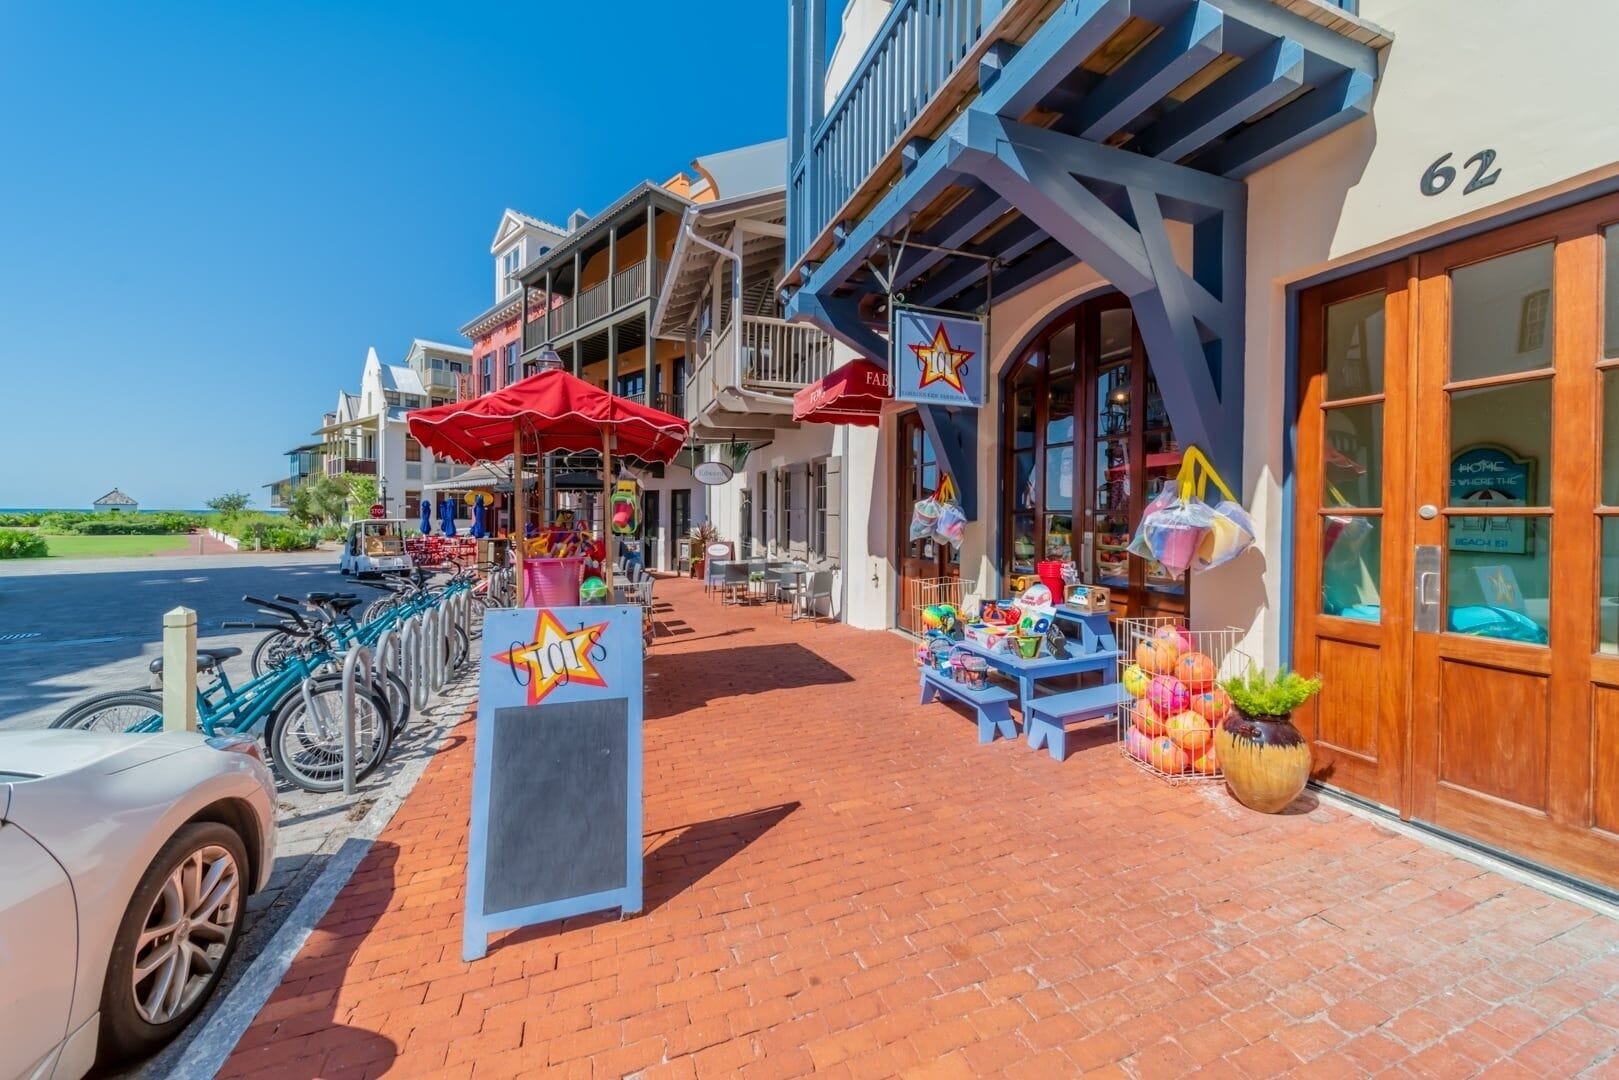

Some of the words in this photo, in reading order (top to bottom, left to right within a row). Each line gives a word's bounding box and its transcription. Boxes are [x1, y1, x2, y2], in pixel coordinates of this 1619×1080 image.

[1420, 149, 1502, 196] 62
[1459, 460, 1505, 473] HOME
[1458, 477, 1494, 486] WHERE
[1495, 476, 1518, 485] THE
[1455, 537, 1490, 547] BEACH
